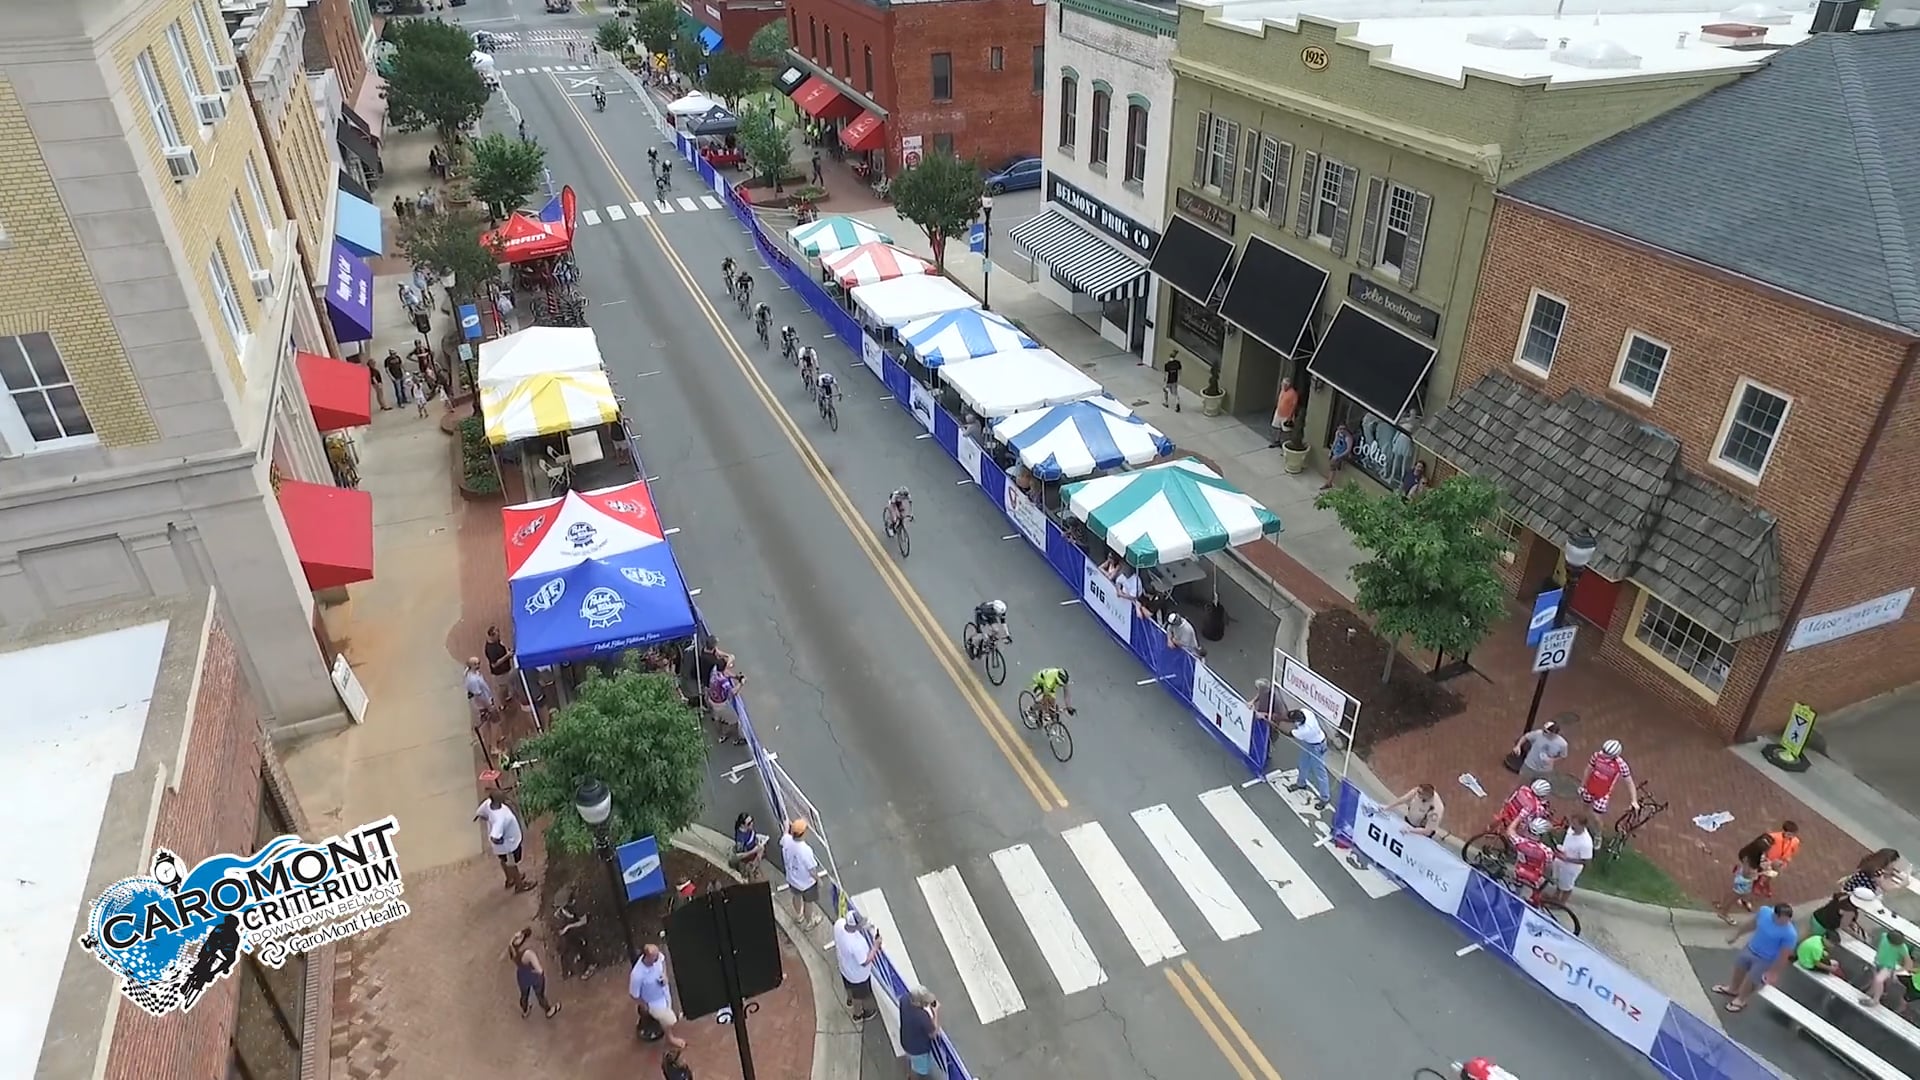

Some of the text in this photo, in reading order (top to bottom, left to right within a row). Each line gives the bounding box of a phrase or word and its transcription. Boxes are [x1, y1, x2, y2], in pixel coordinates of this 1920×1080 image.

[1304, 50, 1325, 66] 1925
[1055, 181, 1150, 250] BELMONT DRUG CO
[1090, 580, 1106, 604] GIG
[1544, 631, 1573, 644] SPEED
[1544, 640, 1568, 652] LIMIT
[1539, 649, 1566, 667] 20
[1198, 677, 1247, 733] ULTRA
[1286, 667, 1340, 720] Course Crossing
[1367, 822, 1404, 858] GIG
[1531, 944, 1642, 1022] confianz
